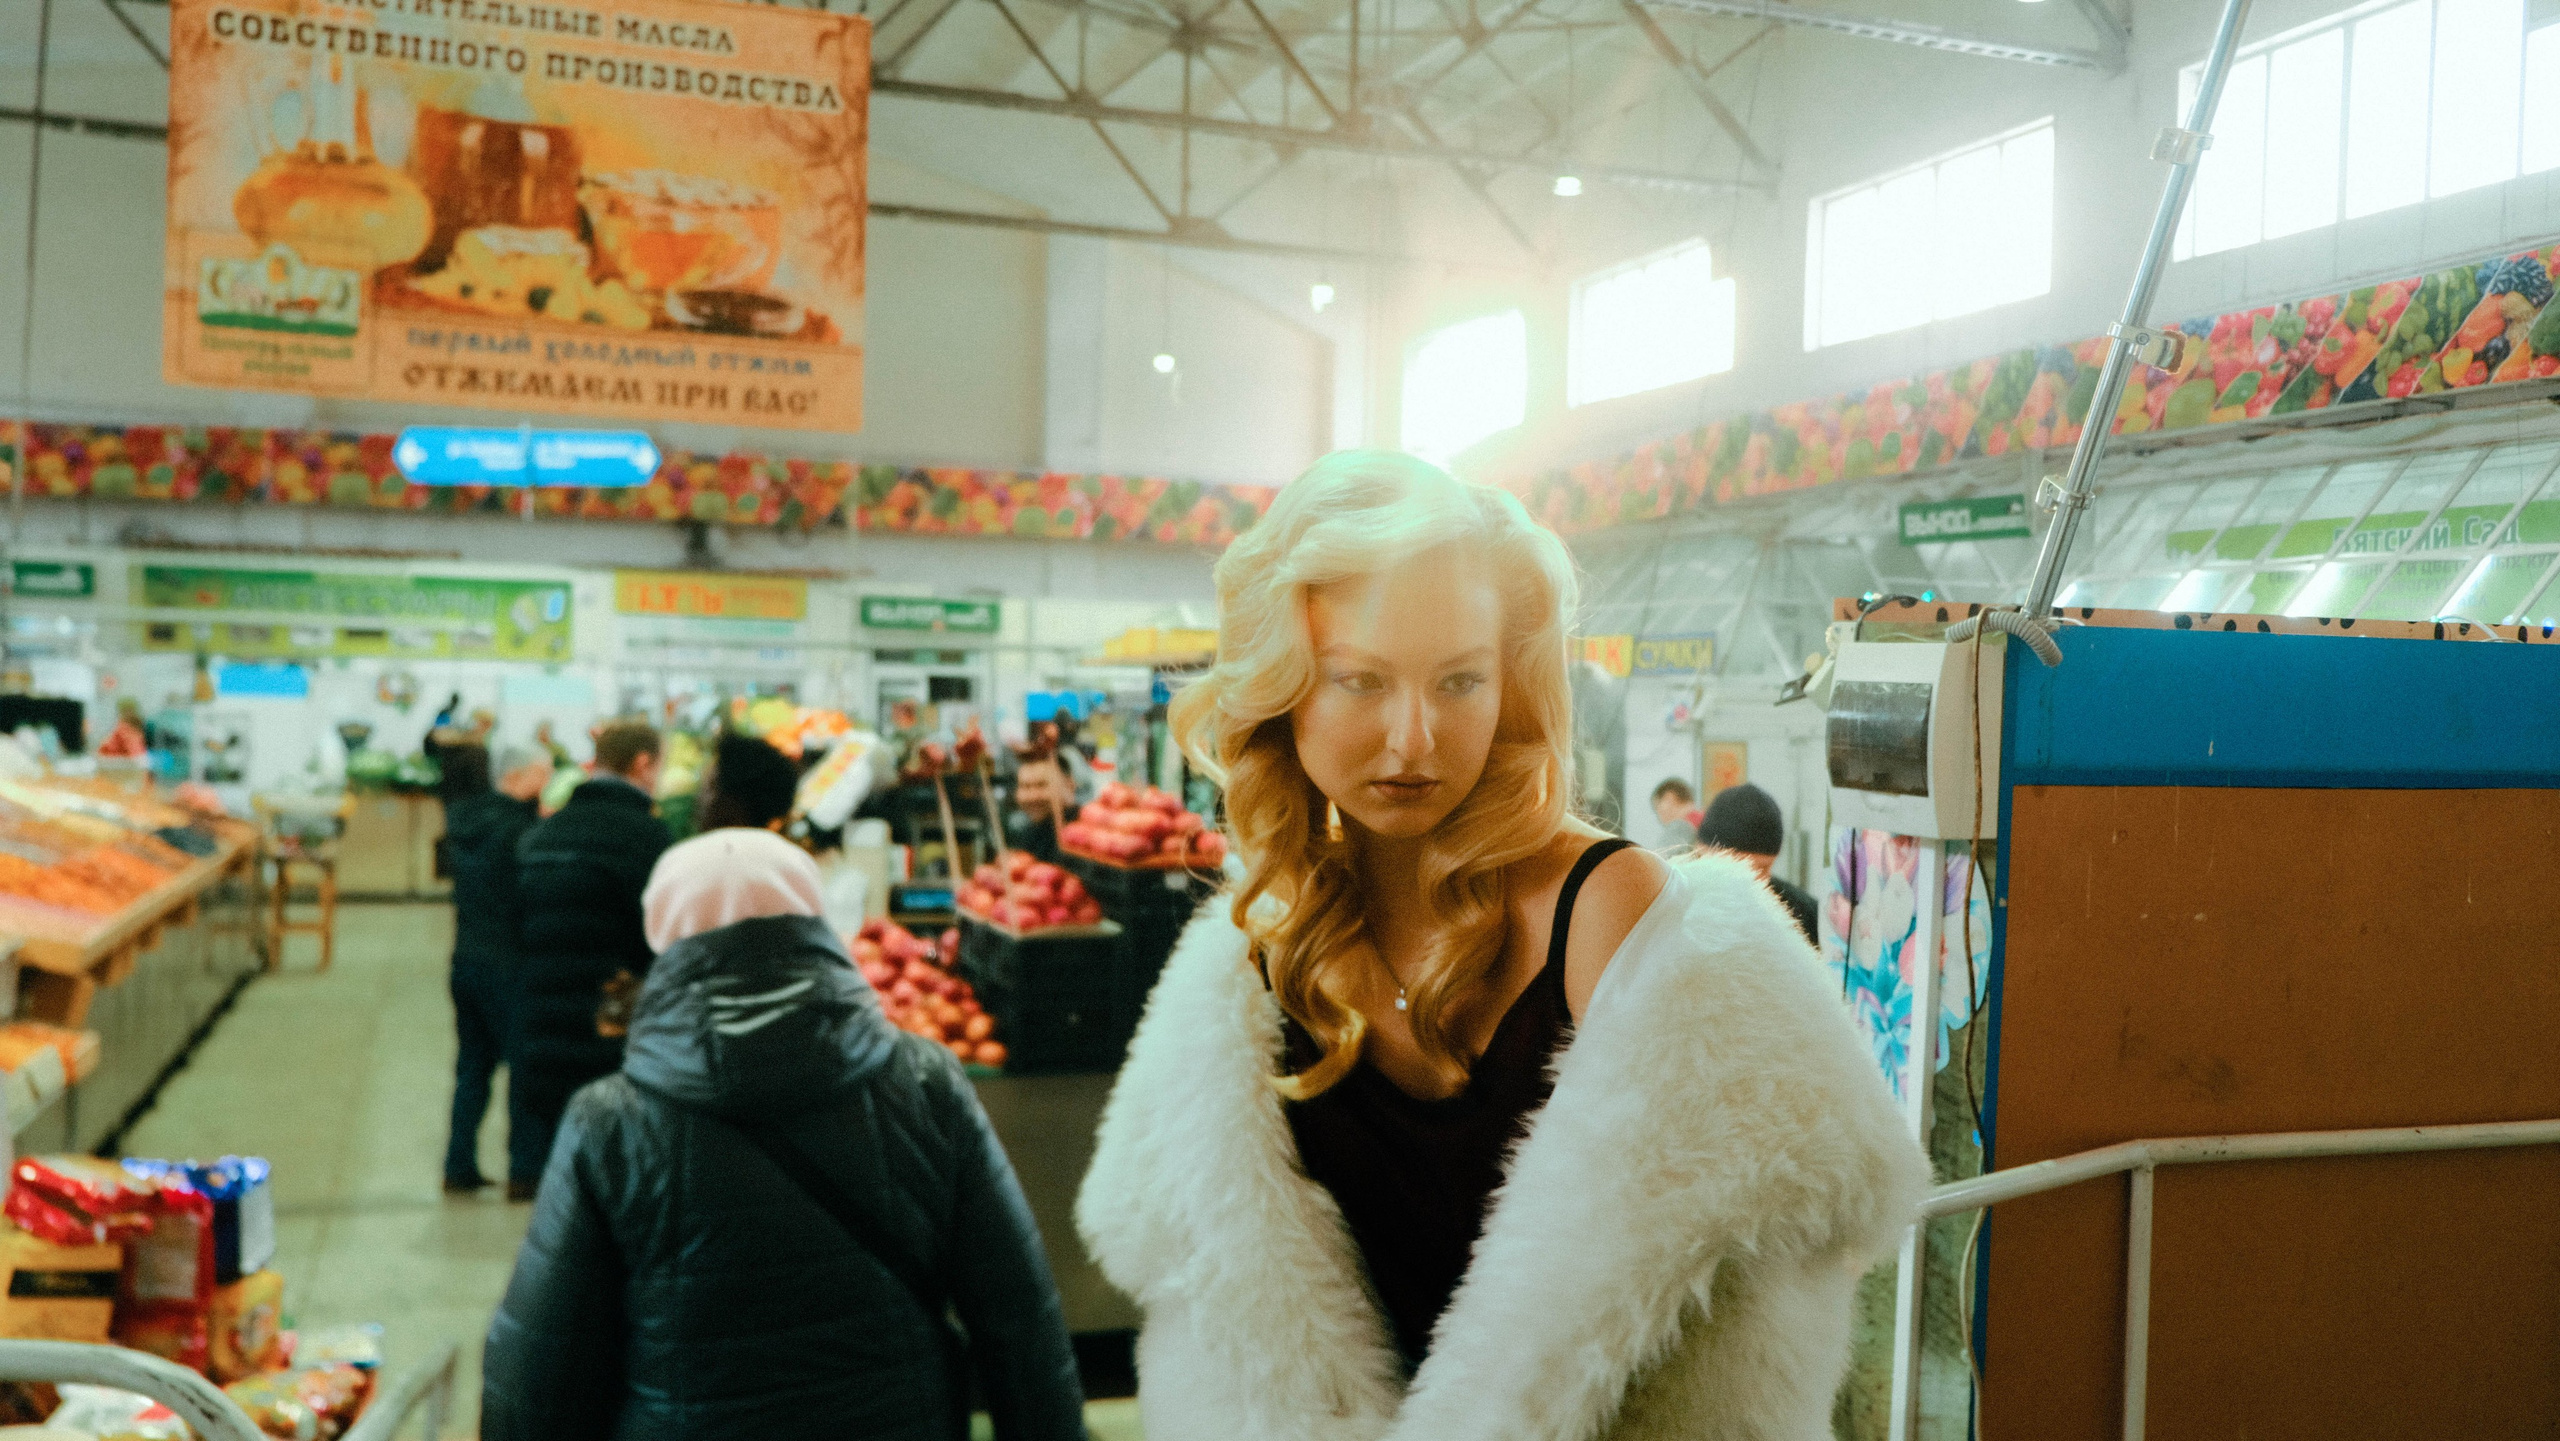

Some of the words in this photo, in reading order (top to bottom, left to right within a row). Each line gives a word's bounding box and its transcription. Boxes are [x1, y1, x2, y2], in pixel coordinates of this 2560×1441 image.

[615, 16, 734, 52] МАСЛА
[213, 9, 527, 73] СОБСТВЕННОГО
[547, 52, 839, 110] ПРОИЗВОДСТВА
[656, 379, 729, 410] ПРИ
